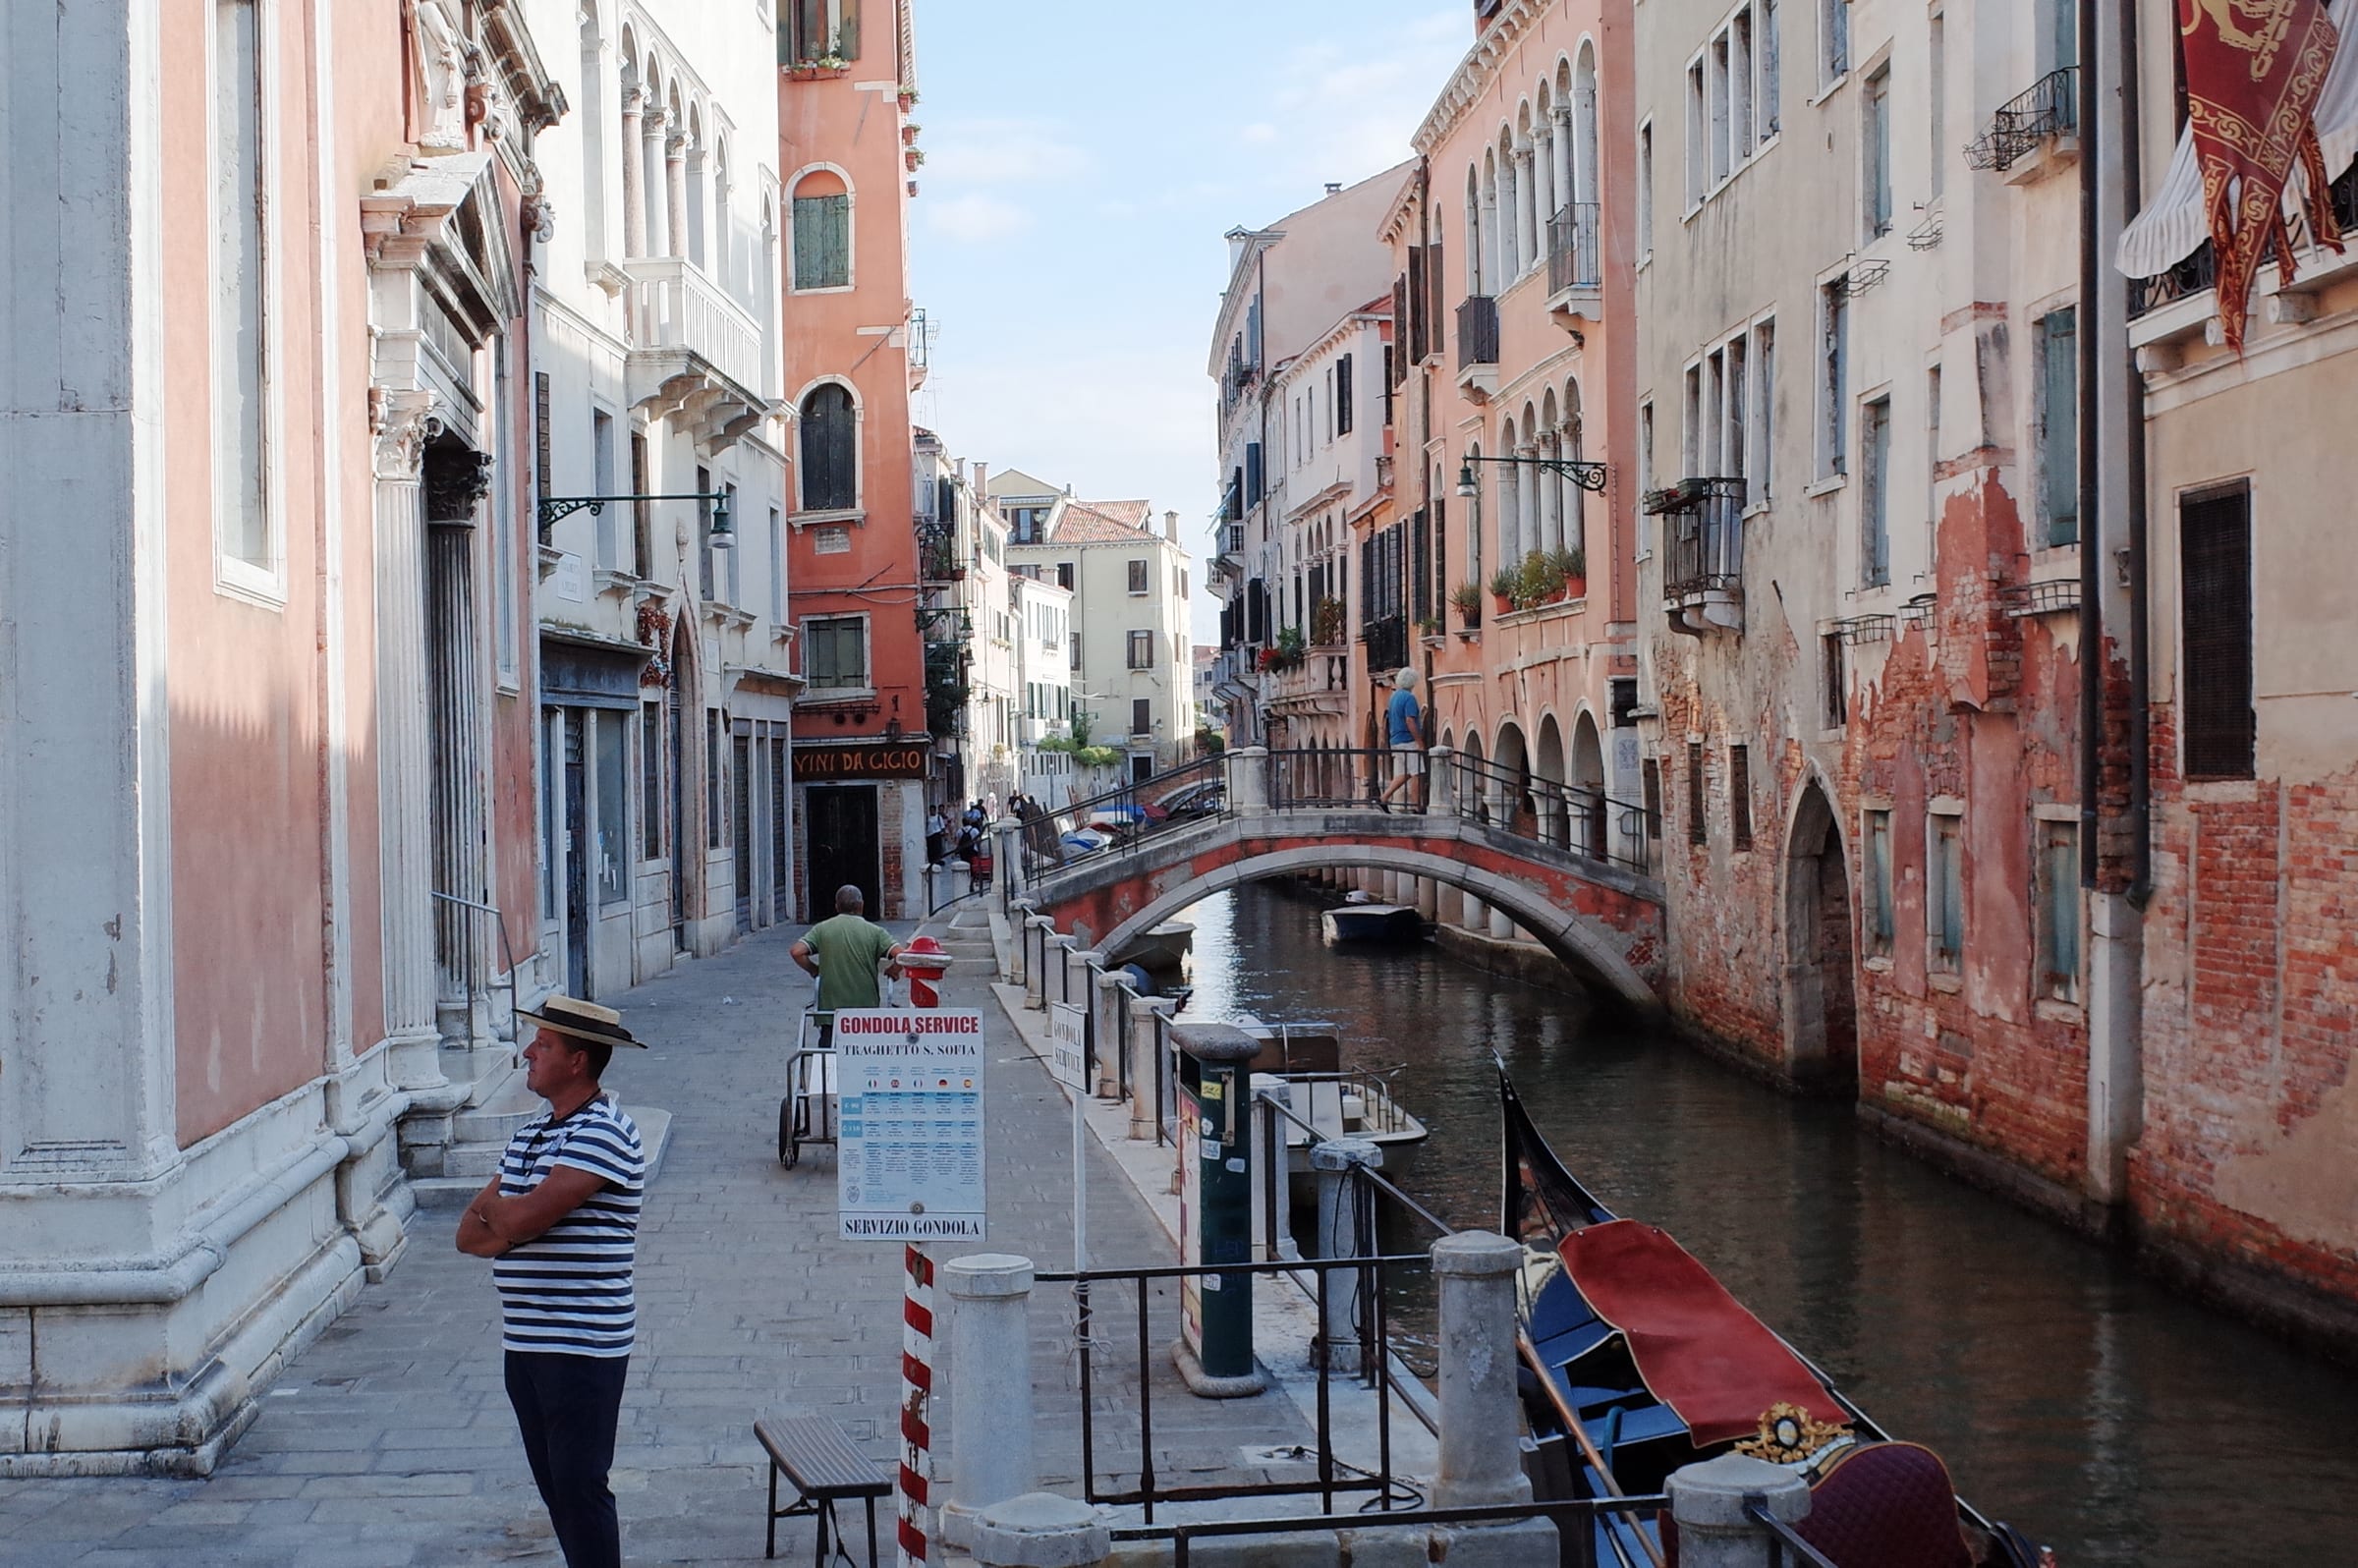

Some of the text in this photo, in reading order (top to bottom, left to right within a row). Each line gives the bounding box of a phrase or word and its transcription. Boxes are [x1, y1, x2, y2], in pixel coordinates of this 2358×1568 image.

[794, 754, 835, 772] VINI
[842, 752, 865, 770] DA
[840, 1017, 979, 1034] GONDOLA SERVICE
[843, 1044, 976, 1055] TRAGHETTO S. SOFIA
[845, 1219, 980, 1235] SERVIZIO GONDOLA
